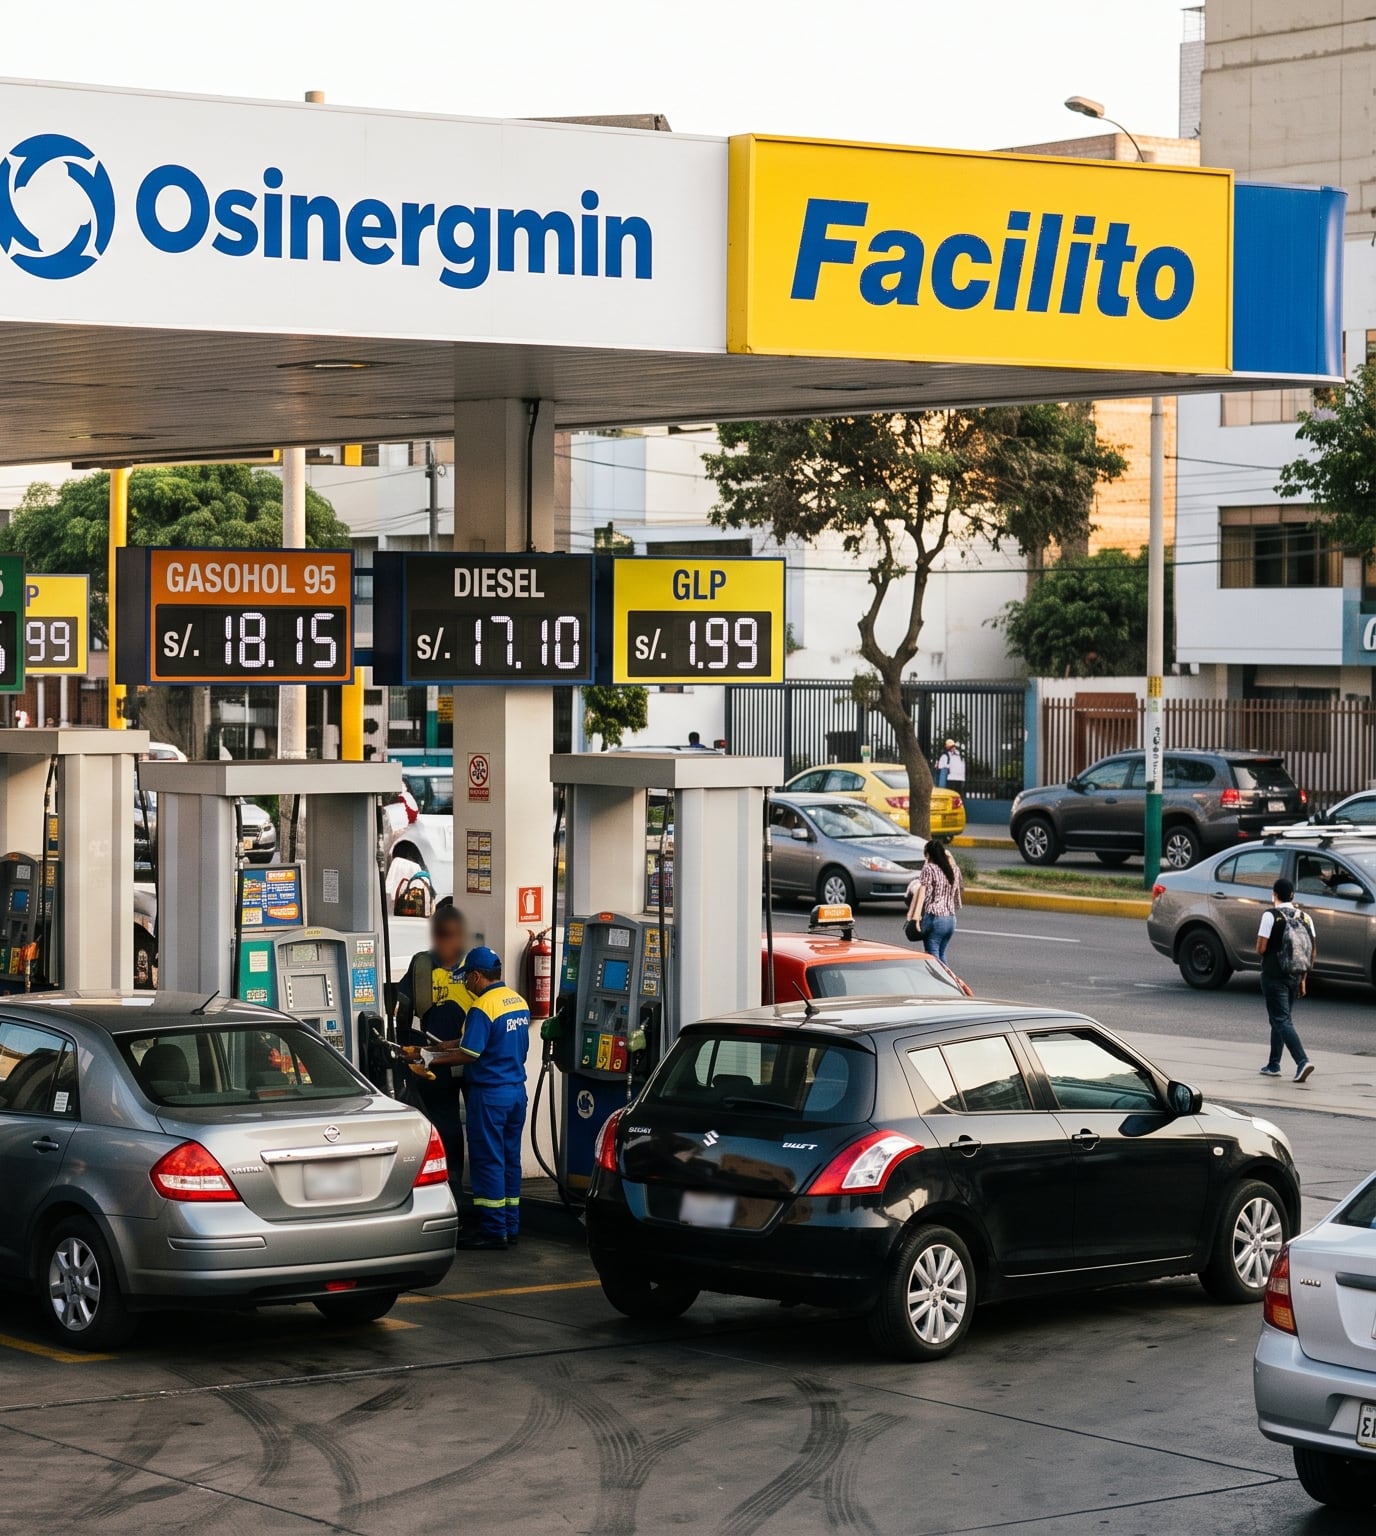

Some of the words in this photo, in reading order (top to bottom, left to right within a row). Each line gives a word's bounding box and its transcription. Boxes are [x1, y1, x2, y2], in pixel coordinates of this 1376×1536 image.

[136, 164, 652, 290] Osinergmin
[791, 198, 1195, 321] Facilito
[166, 562, 296, 594] GASOHOL
[303, 564, 336, 595] 95
[454, 567, 545, 598] DIESEL
[672, 569, 727, 601] GLP
[224, 612, 337, 668] 18.15
[475, 615, 580, 670] 17.10
[689, 617, 758, 669] 1.99
